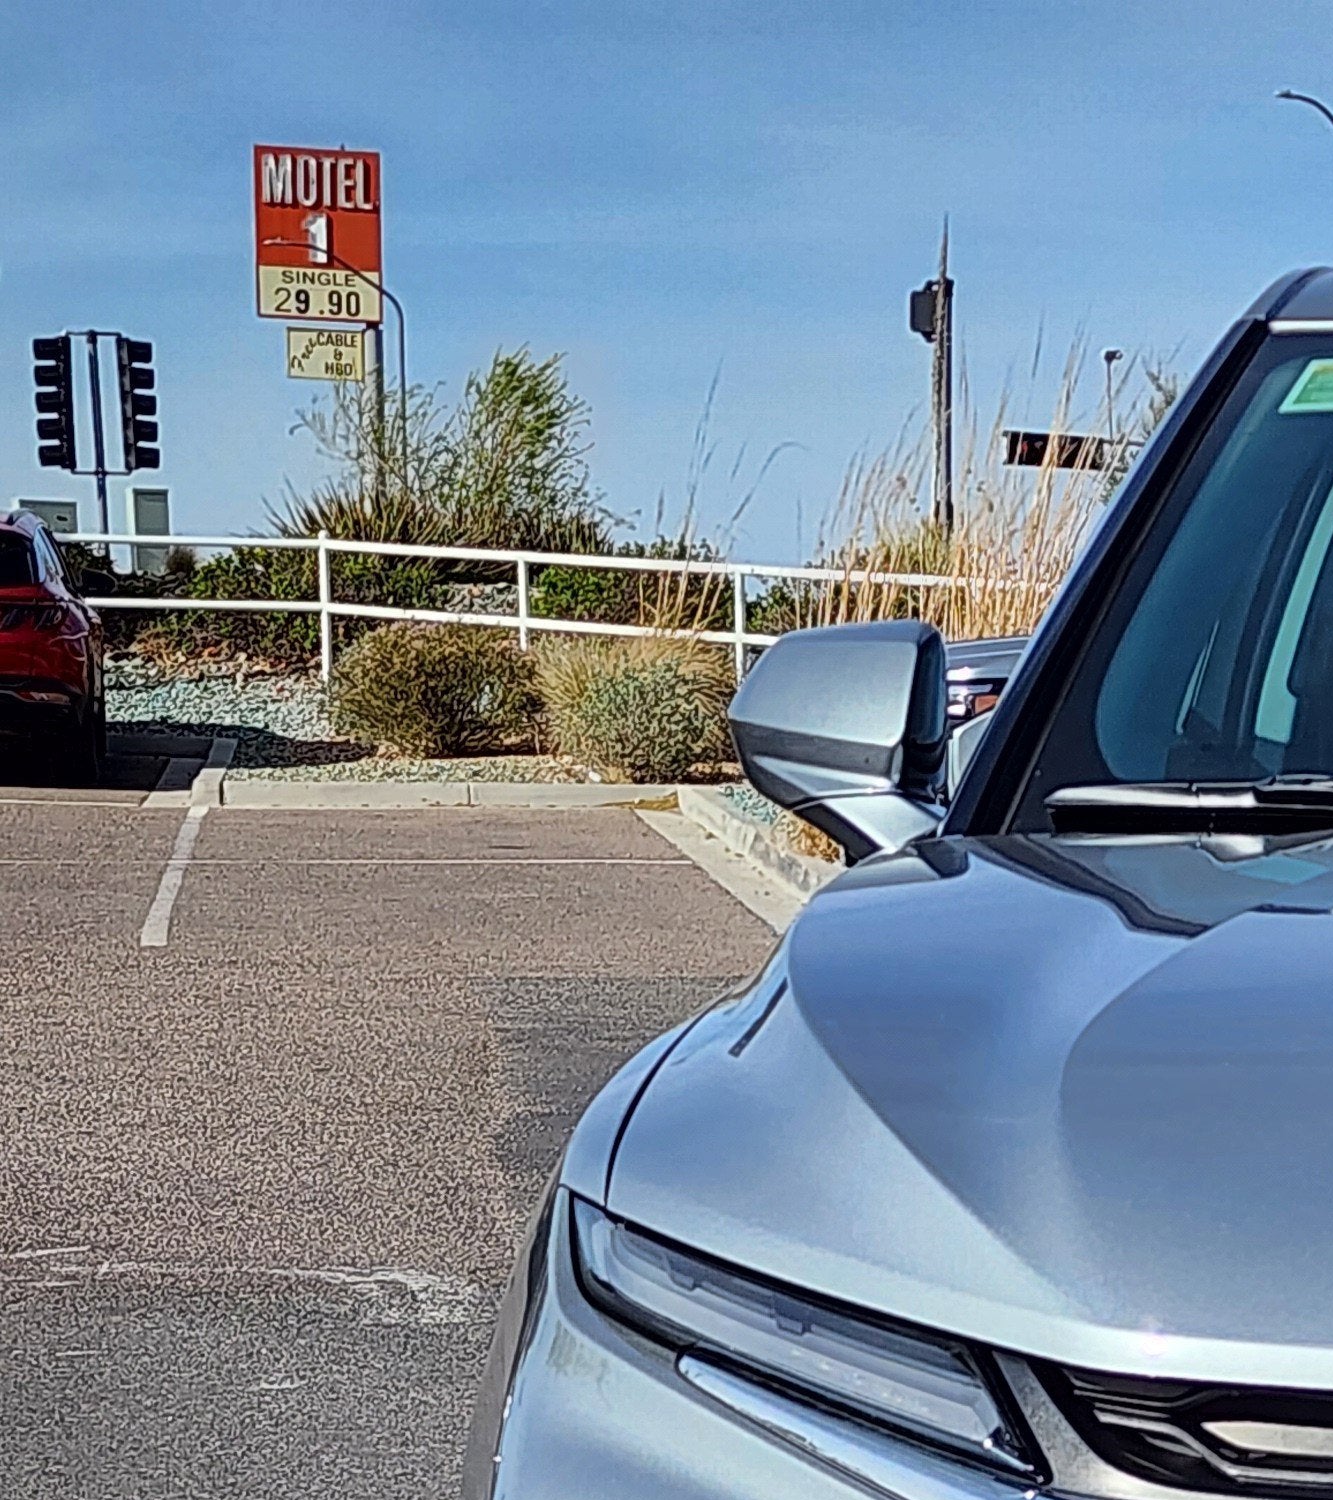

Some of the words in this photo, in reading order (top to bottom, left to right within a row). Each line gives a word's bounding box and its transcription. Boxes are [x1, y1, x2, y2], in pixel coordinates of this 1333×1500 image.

[261, 153, 374, 210] MOTEL
[302, 212, 328, 264] 1
[281, 270, 356, 288] SINGLE
[316, 332, 358, 348] CABLE
[333, 348, 343, 361] &
[325, 362, 353, 377] HBO
